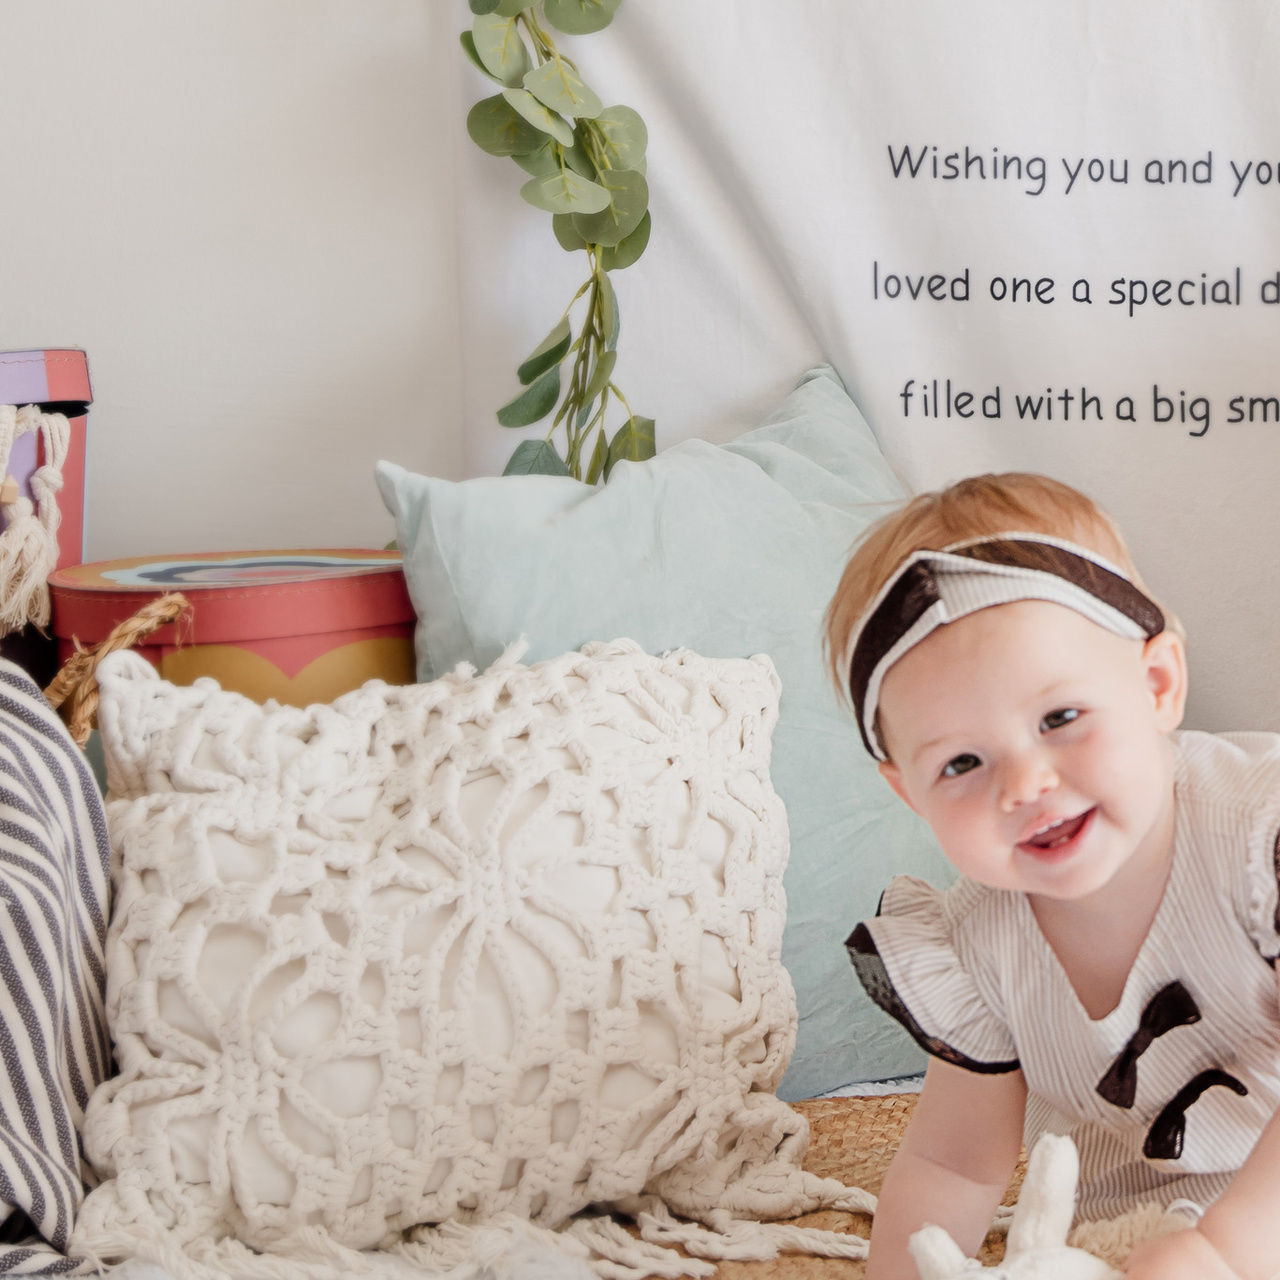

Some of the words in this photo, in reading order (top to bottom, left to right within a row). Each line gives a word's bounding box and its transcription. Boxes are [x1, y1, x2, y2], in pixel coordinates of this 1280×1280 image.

[887, 144, 1046, 196] Wishing
[1061, 158, 1128, 195] you
[1144, 150, 1213, 185] and
[873, 260, 970, 302] loved
[989, 276, 1055, 305] one
[1072, 278, 1093, 305] a
[1108, 266, 1241, 318] special
[899, 378, 1002, 419] filled
[1014, 386, 1104, 422] with
[1115, 396, 1137, 423] a
[1152, 383, 1211, 438] big
